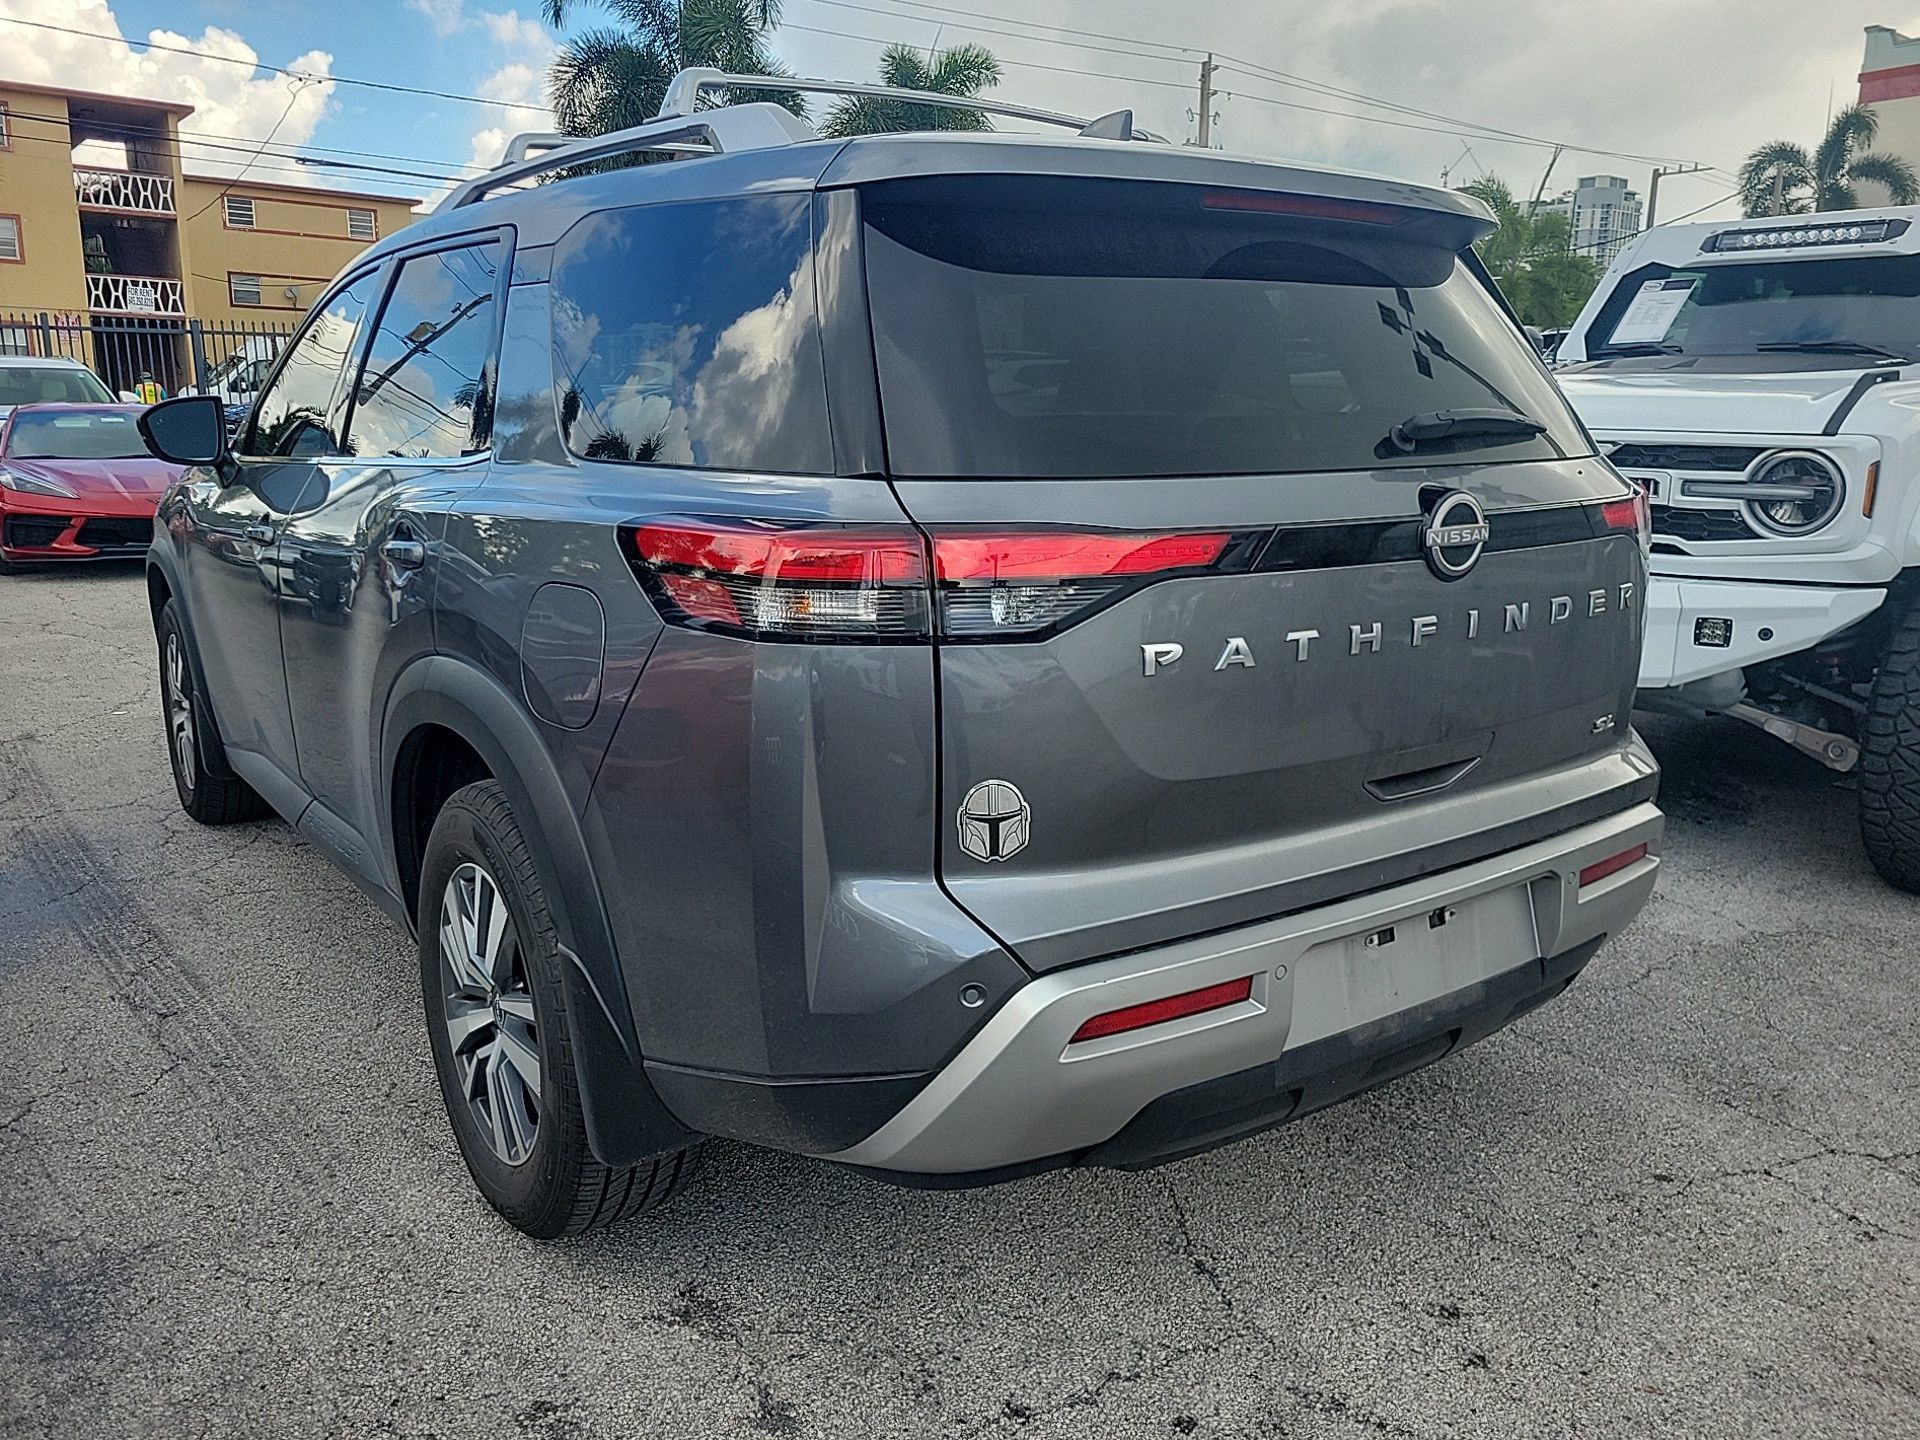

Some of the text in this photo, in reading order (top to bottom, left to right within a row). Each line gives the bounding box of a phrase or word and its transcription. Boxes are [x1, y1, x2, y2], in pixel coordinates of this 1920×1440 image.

[128, 287, 153, 298] FOR RENT
[1429, 527, 1489, 544] NISSAN
[1140, 582, 1634, 676] PATHFINDER
[1591, 713, 1615, 733] SL
